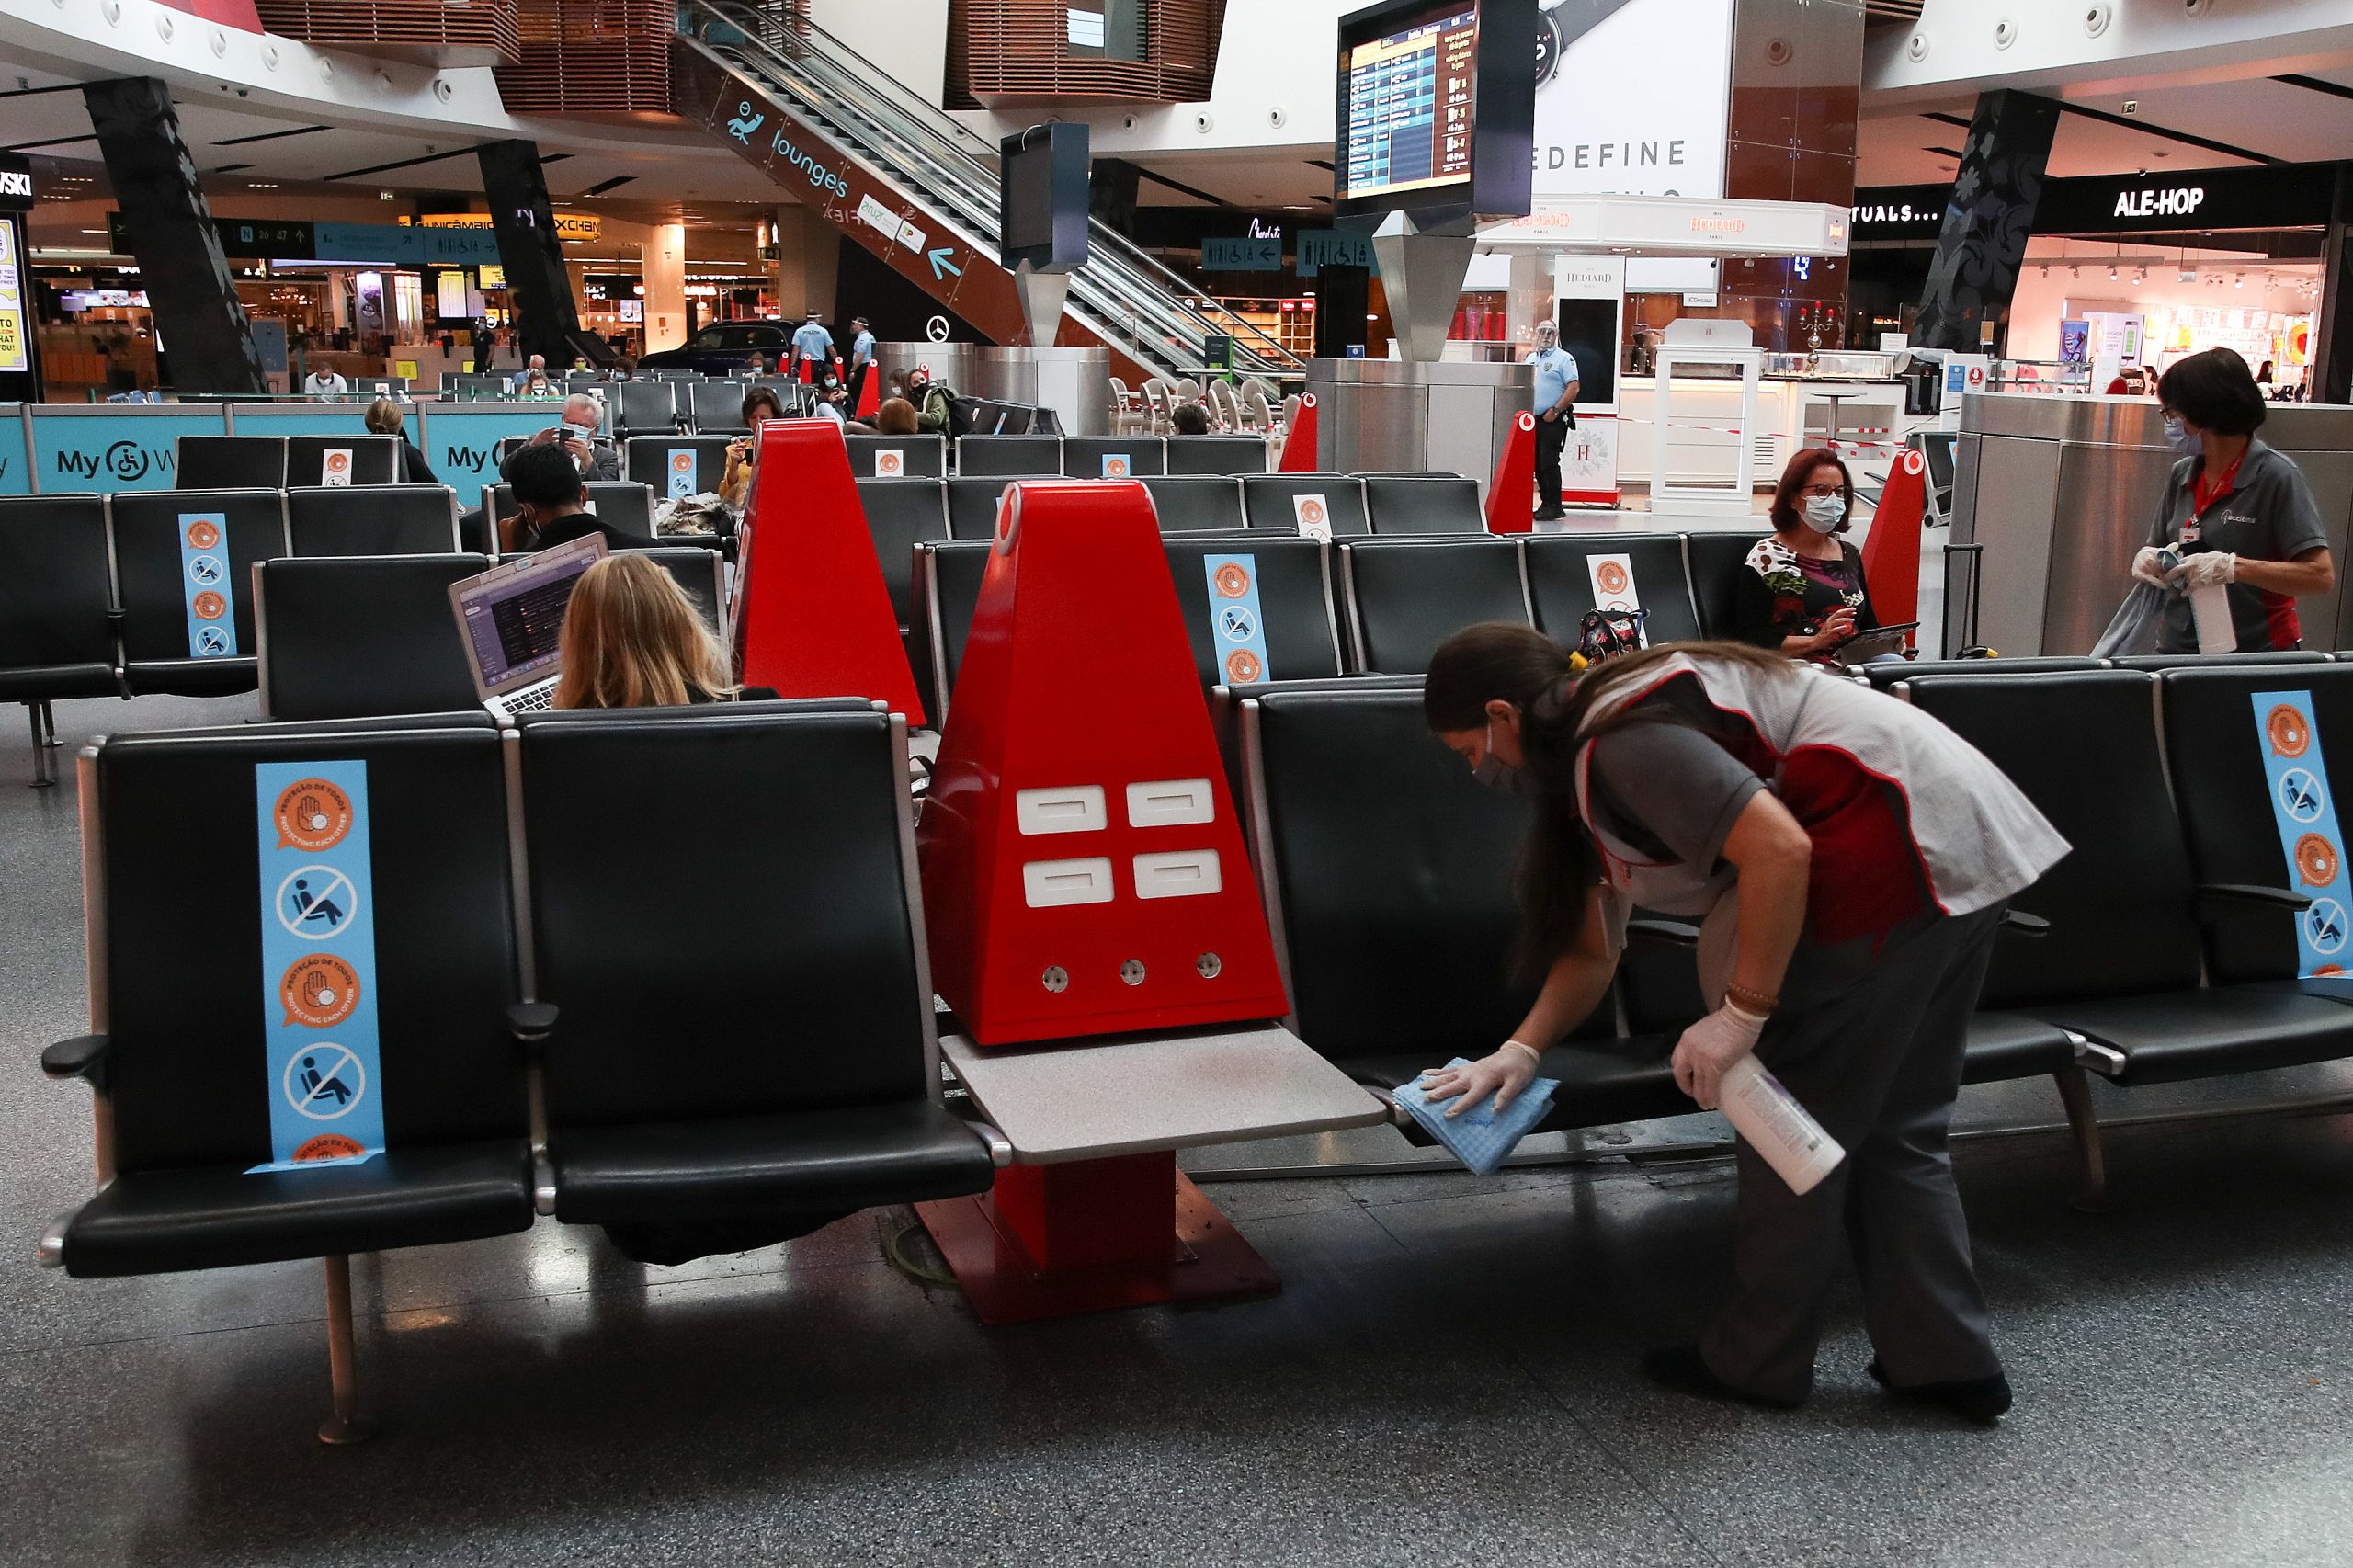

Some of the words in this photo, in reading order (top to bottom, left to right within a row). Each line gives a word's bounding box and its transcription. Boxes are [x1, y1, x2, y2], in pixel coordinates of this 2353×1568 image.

[771, 129, 849, 198] lounges
[2114, 187, 2204, 217] ALE-HOP
[1690, 216, 1745, 233] HEDIARD
[1567, 273, 1612, 283] HEDIARD
[57, 450, 100, 479] My
[448, 446, 487, 473] My
[280, 783, 313, 813] PROTEÇÃO
[326, 787, 346, 811] TODOS
[280, 815, 315, 847] PROTECTING
[315, 834, 335, 847] EACH
[334, 813, 347, 837] OTHER
[287, 958, 320, 990] PROTEÇÃO
[322, 958, 333, 966] DE
[334, 960, 353, 986] TODOS
[286, 992, 323, 1024] PROTECTING
[323, 1011, 342, 1023] EACH
[340, 988, 355, 1014] OTHER
